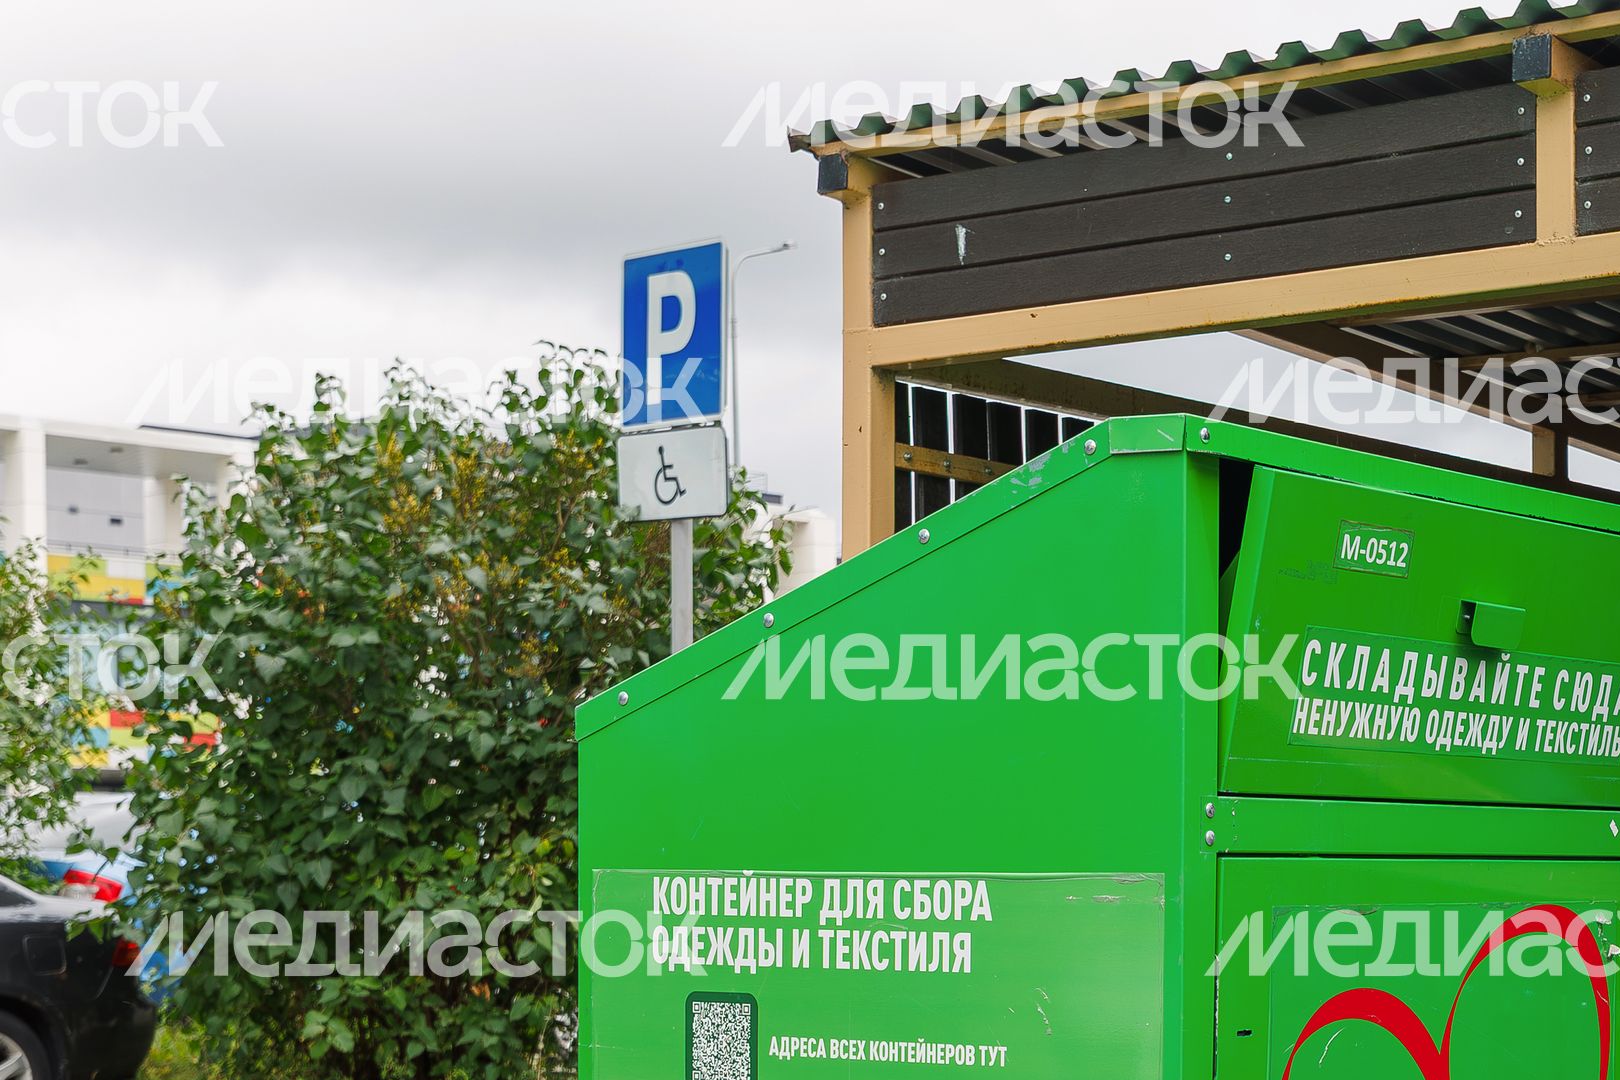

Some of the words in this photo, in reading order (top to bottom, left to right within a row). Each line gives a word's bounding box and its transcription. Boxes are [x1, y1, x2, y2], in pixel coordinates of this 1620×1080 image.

[647, 270, 696, 405] P
[1301, 638, 1546, 709] СКЛАДЫВАЙТЕ
[1293, 697, 1421, 742] НЕНУЖНУЮ
[1425, 708, 1512, 755] ОДЕЖДУ
[1515, 717, 1528, 750] И
[653, 871, 812, 920] КОНТЕЙНЕР
[819, 881, 888, 926] ДЛЯ
[893, 881, 992, 922] СБОРА
[652, 925, 783, 974] ОДЕЖДЫ
[792, 929, 811, 968] И
[817, 929, 972, 973] ТЕКСТИЛЯ
[769, 1036, 827, 1060] АДРЕСА
[830, 1039, 865, 1061] ВСЕХ
[869, 1037, 975, 1067] КОНТЕЙНЕРОВ
[978, 1045, 1007, 1067] ТУТ
